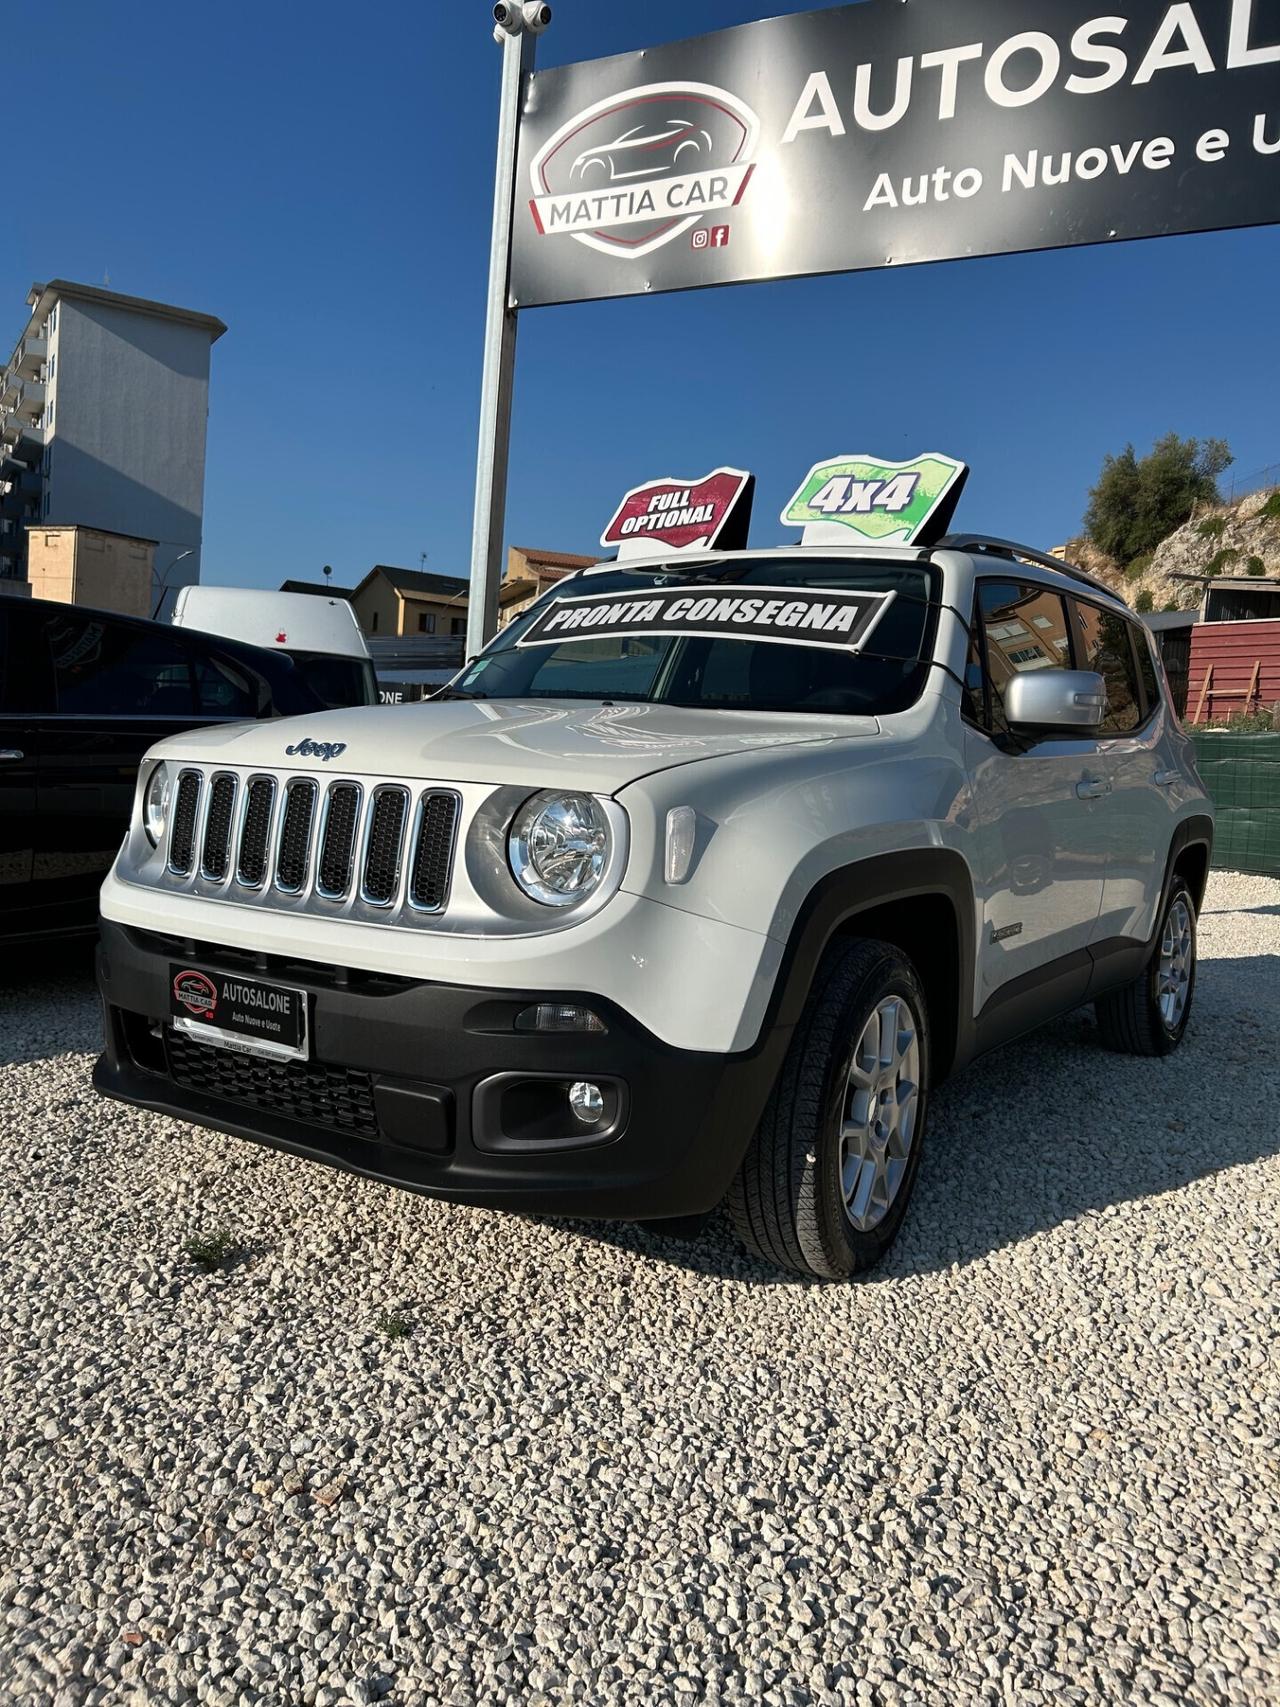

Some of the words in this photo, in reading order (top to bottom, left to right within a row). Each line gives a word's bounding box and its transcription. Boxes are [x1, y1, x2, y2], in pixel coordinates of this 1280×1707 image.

[780, 0, 1280, 144] AUTOSAL
[863, 166, 983, 212] Auto
[1002, 137, 1175, 192] Nuove
[1196, 128, 1230, 162] e
[549, 189, 656, 226] MATTIA
[666, 176, 729, 208] CAR
[647, 489, 692, 513] FULL
[808, 473, 919, 513] 4x4
[620, 503, 715, 535] OPTIONAL
[543, 599, 666, 632] PRONTA
[662, 597, 859, 632] CONSEGNA
[285, 737, 346, 762] Jeep
[222, 982, 291, 1015] AUTOSALONE
[232, 1011, 244, 1023] Auto
[245, 1014, 261, 1027] Nuove
